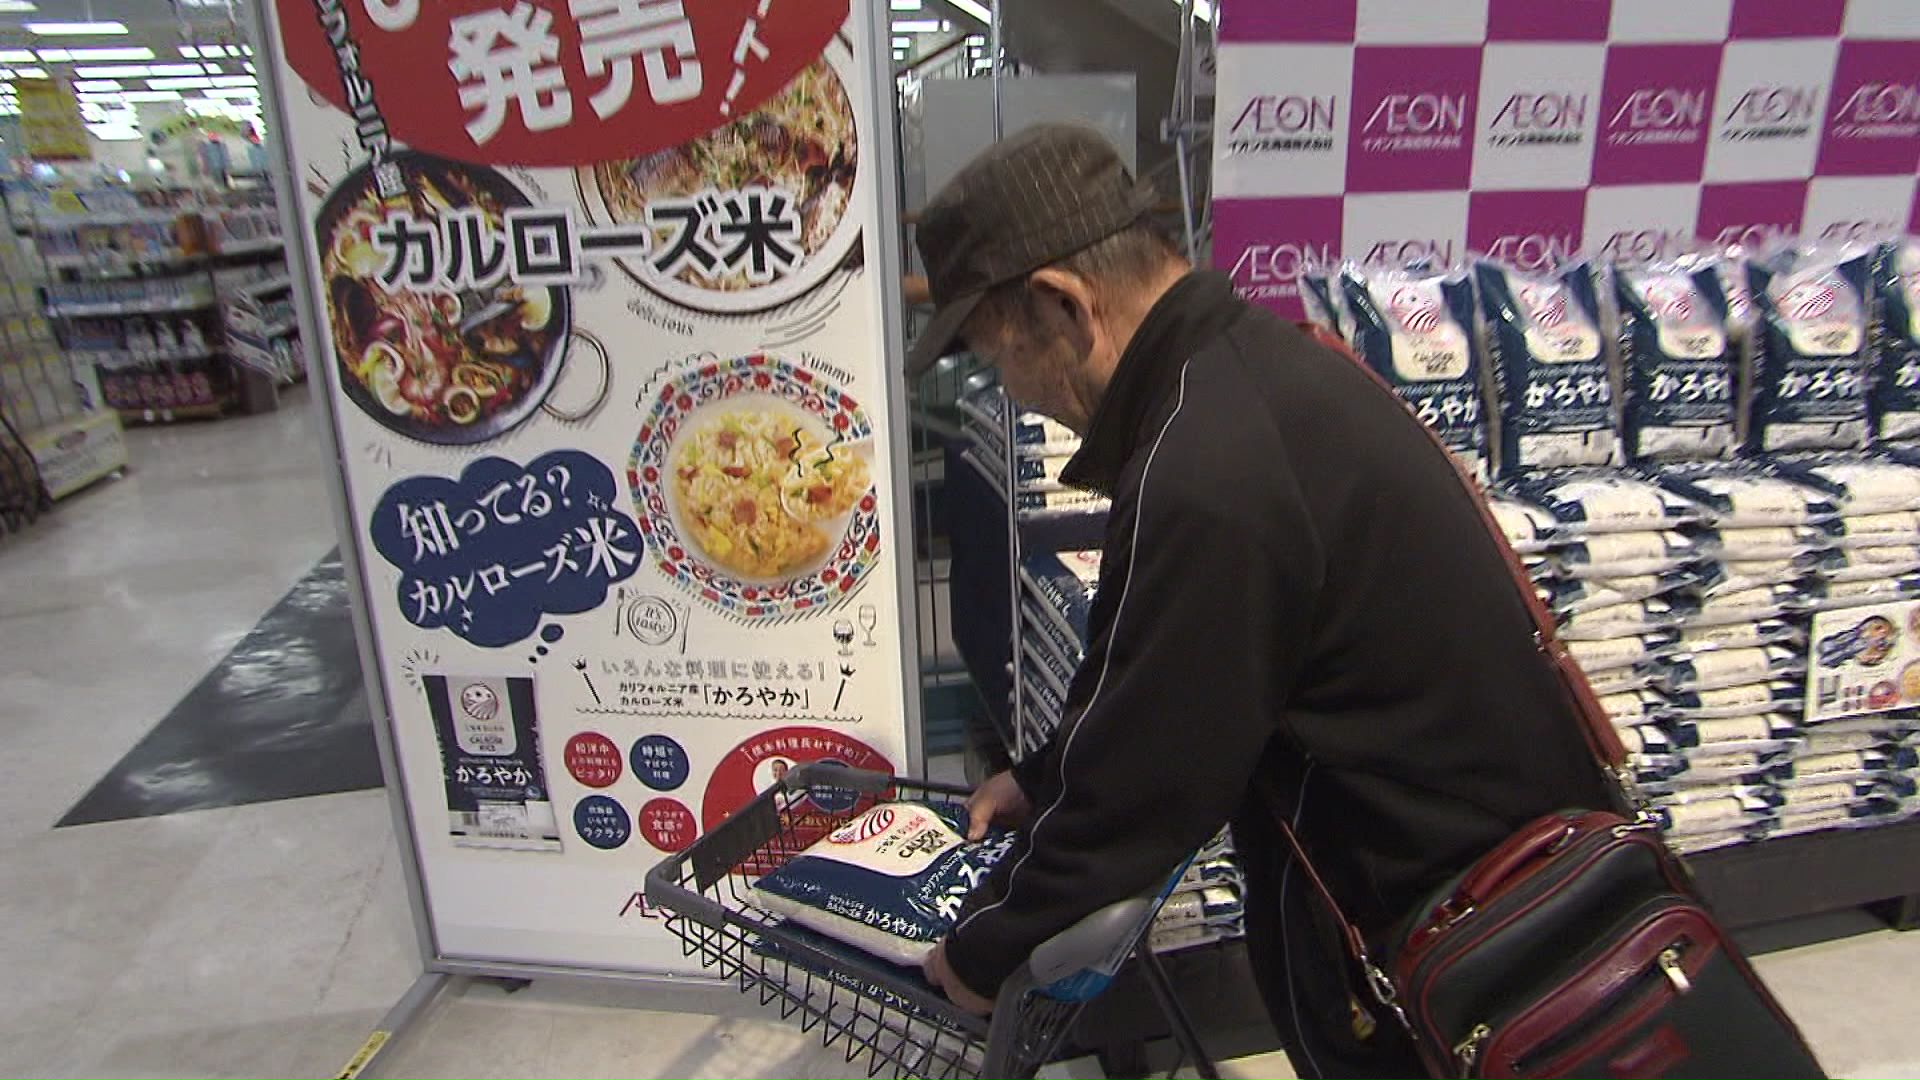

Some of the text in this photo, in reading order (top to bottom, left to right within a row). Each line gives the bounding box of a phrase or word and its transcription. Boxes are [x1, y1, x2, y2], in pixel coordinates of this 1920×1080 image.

[449, 0, 704, 148] 発売
[376, 196, 796, 288] カルローズ米
[398, 465, 571, 564] 知ってる?
[408, 517, 637, 625] カルローズ米
[600, 659, 826, 681] いろんな料理に使える!
[619, 682, 699, 695] カリフォルニア産
[620, 695, 685, 708] カルローズ米
[455, 765, 534, 787] かろやか
[864, 905, 923, 939] かろやか
